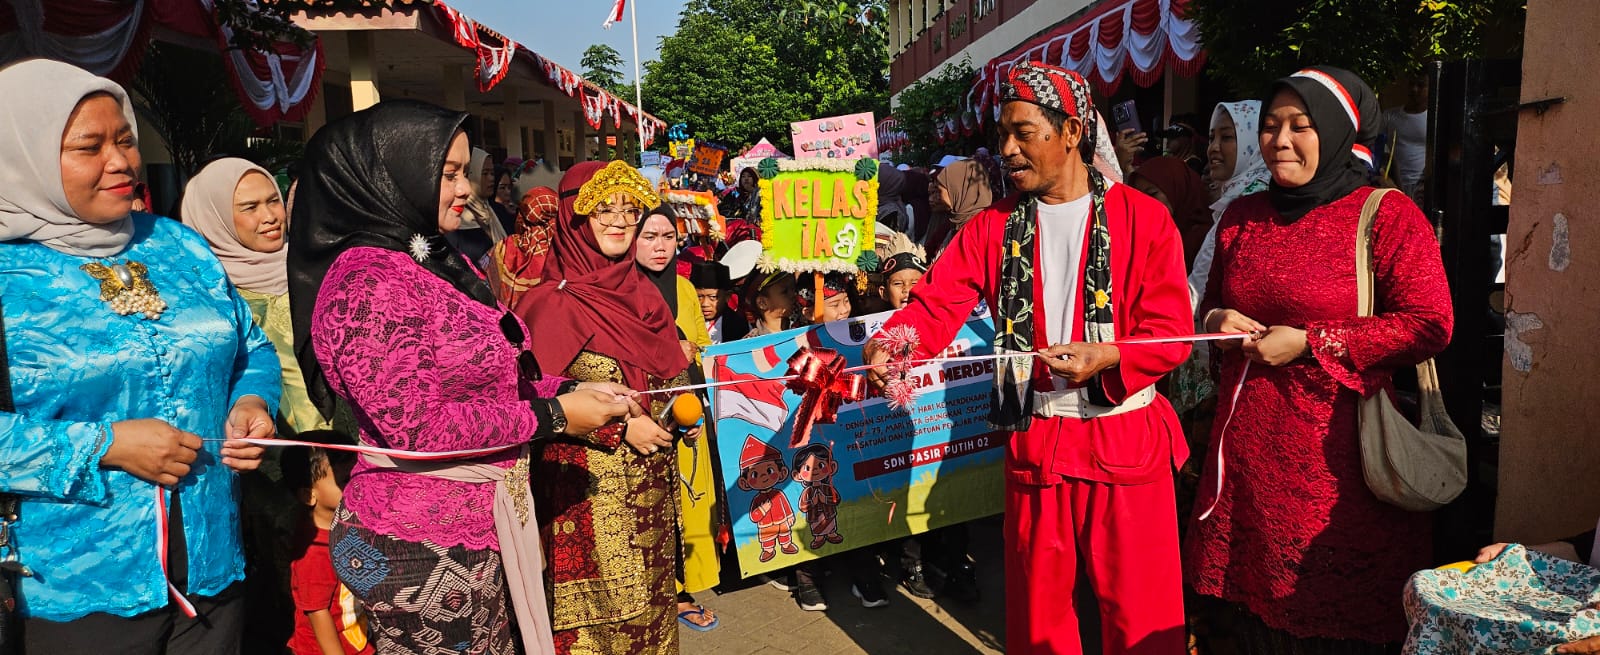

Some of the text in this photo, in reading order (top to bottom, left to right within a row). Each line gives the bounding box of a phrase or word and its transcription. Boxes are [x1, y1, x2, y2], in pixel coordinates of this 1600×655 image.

[772, 178, 869, 219] KELAS
[938, 359, 994, 383] MERDE
[845, 416, 874, 431] DENGAN
[917, 402, 935, 414] HARI
[885, 422, 904, 432] MARI
[888, 433, 903, 442] DAN
[904, 424, 941, 438] KESATUAN
[883, 437, 989, 469] SDN PASIR PUTIH 02
